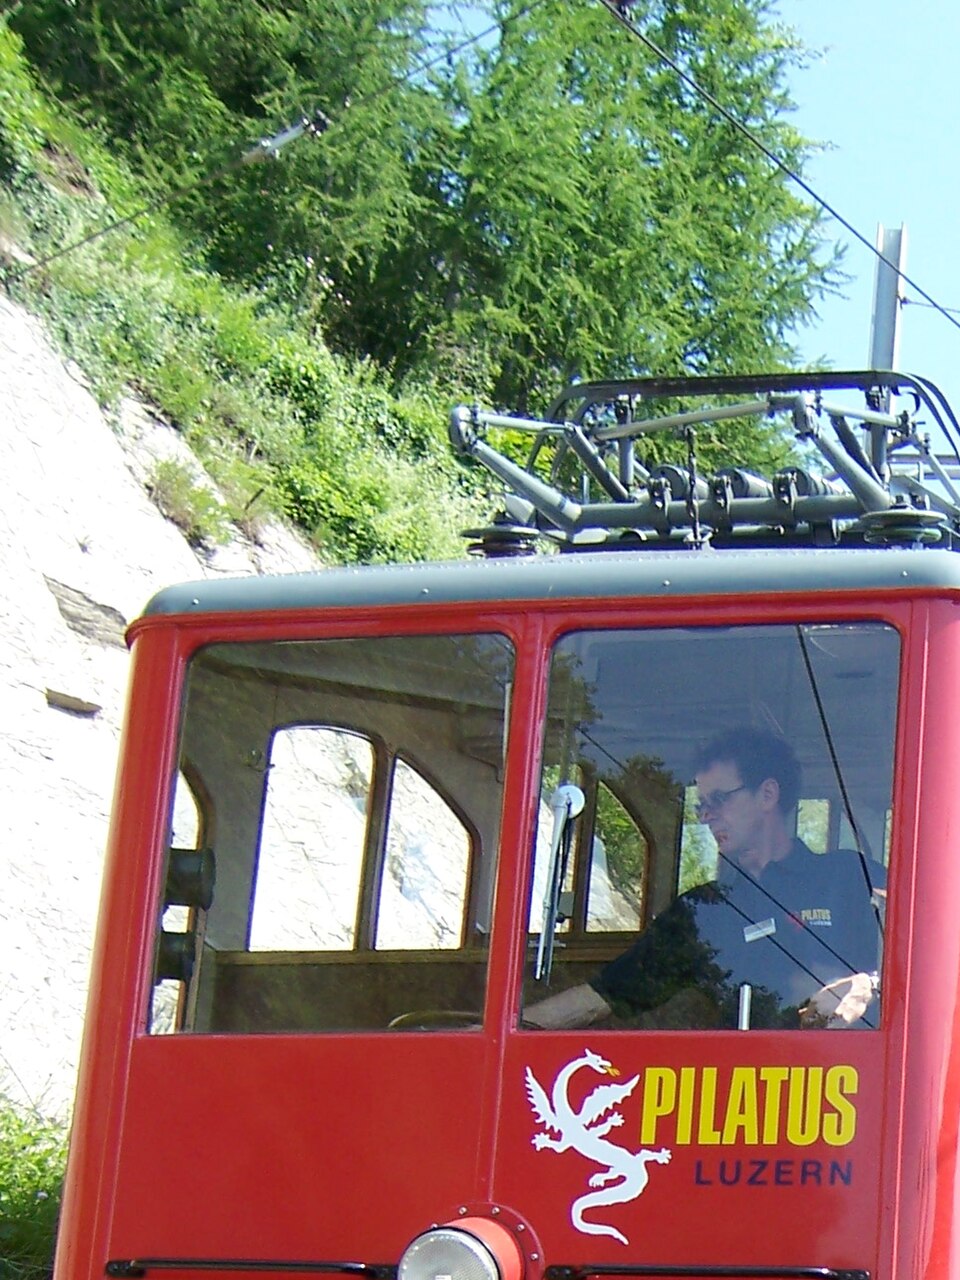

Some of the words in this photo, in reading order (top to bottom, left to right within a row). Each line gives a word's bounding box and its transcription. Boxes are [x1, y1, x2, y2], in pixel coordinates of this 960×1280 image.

[801, 908, 832, 921] PILATUS
[640, 1065, 859, 1146] PILATUS
[695, 1159, 854, 1186] LUZERN
